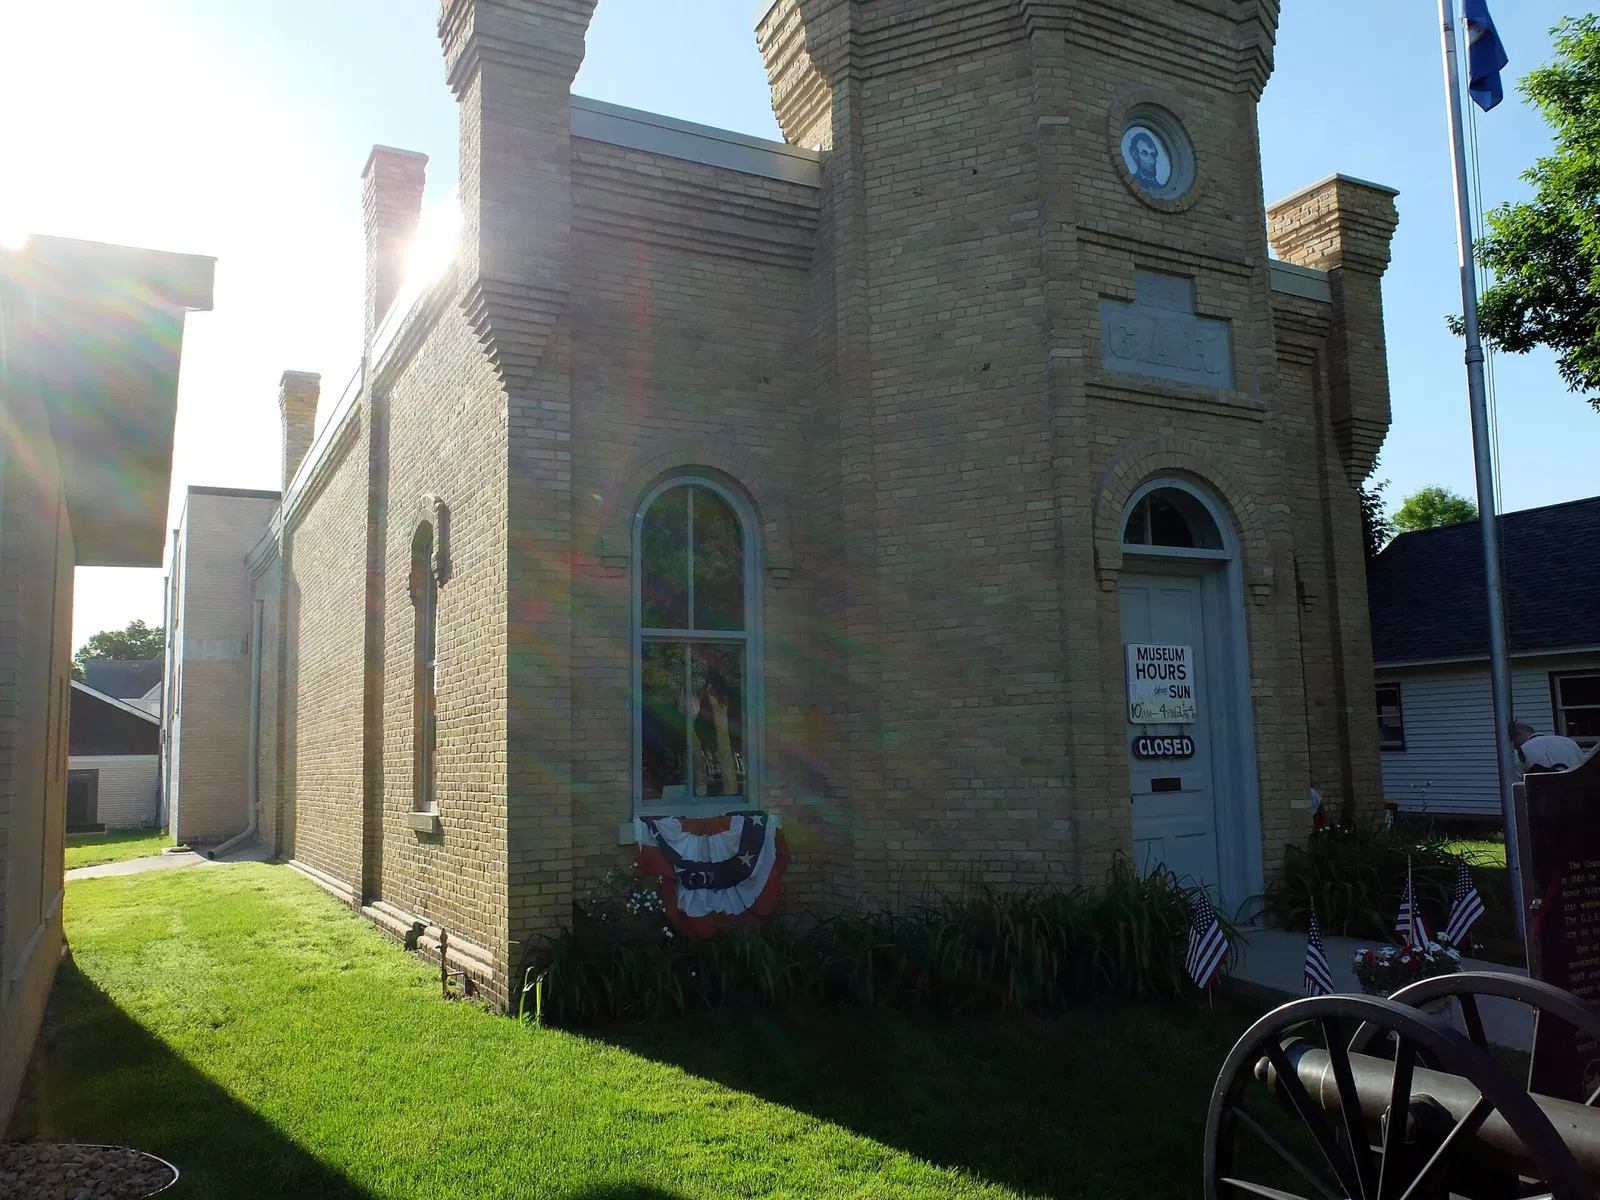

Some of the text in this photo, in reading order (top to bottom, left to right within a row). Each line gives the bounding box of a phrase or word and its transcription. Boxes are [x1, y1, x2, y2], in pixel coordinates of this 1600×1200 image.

[1136, 647, 1185, 662] MUSEUM
[1135, 663, 1187, 680] HOURS
[1168, 684, 1191, 699] SUN
[1138, 738, 1192, 756] CLOSED
[1568, 861, 1581, 870] The
[1588, 873, 1597, 882] by
[1564, 903, 1577, 912] also
[1564, 916, 1577, 926] The
